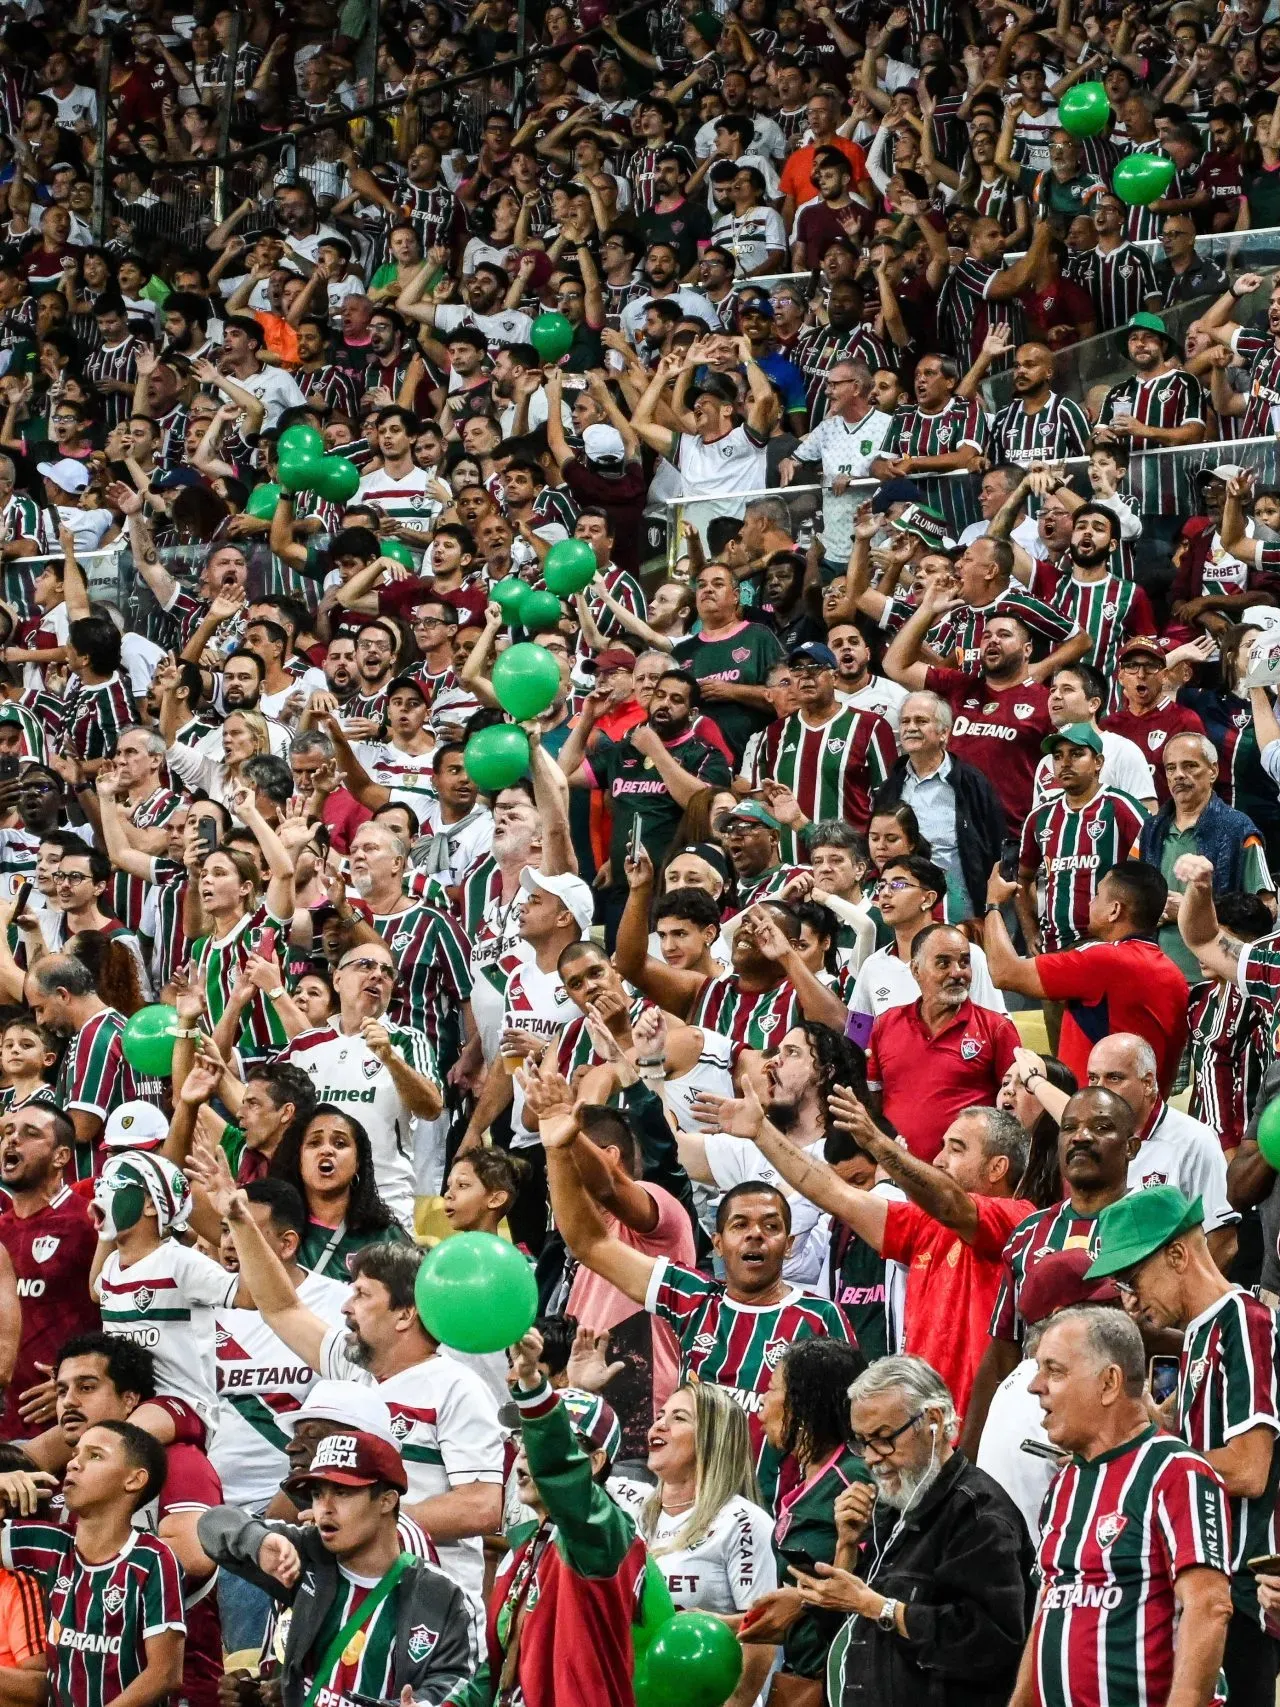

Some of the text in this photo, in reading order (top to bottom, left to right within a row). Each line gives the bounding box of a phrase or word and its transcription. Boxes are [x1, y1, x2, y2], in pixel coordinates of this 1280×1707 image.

[412, 209, 444, 224] BETANO
[1005, 446, 1055, 461] SUPERBET
[966, 721, 1017, 741] BETANO
[1052, 855, 1099, 871] BETANO
[228, 1366, 313, 1388] BETANO
[1044, 1585, 1123, 1611] BETANO
